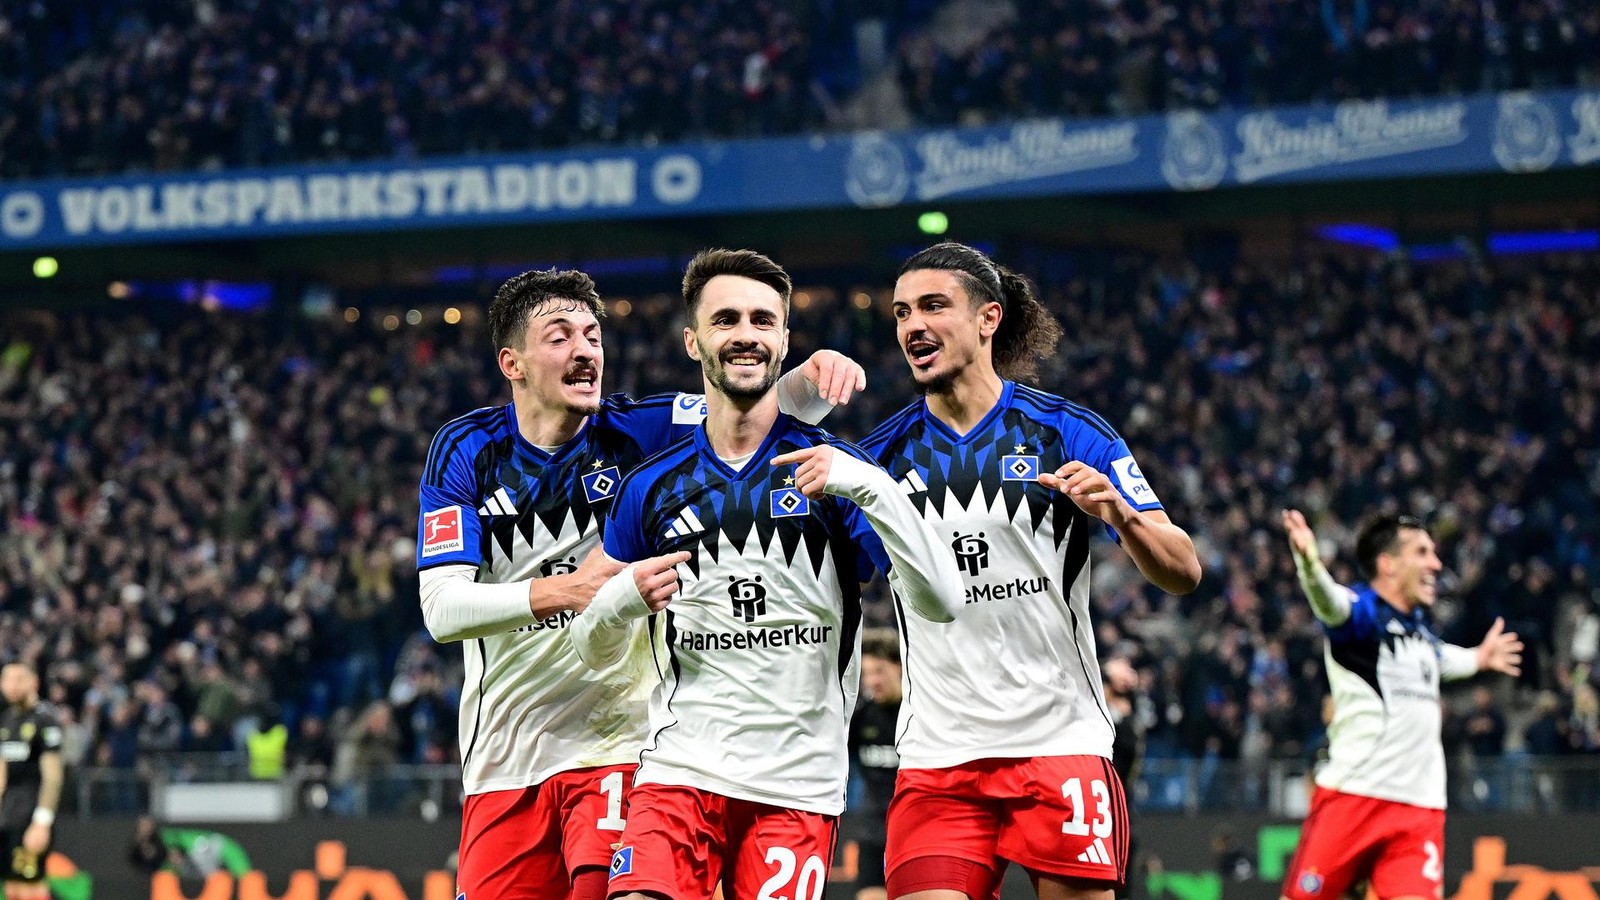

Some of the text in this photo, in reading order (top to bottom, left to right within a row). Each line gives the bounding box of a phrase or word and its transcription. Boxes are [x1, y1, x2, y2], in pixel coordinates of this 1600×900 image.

[62, 160, 636, 234] VOLKSPARKSTADION
[425, 542, 459, 553] BUNDESLIGA
[681, 624, 832, 651] HanseMerkur
[1061, 778, 1112, 838] 13
[757, 846, 825, 900] 20
